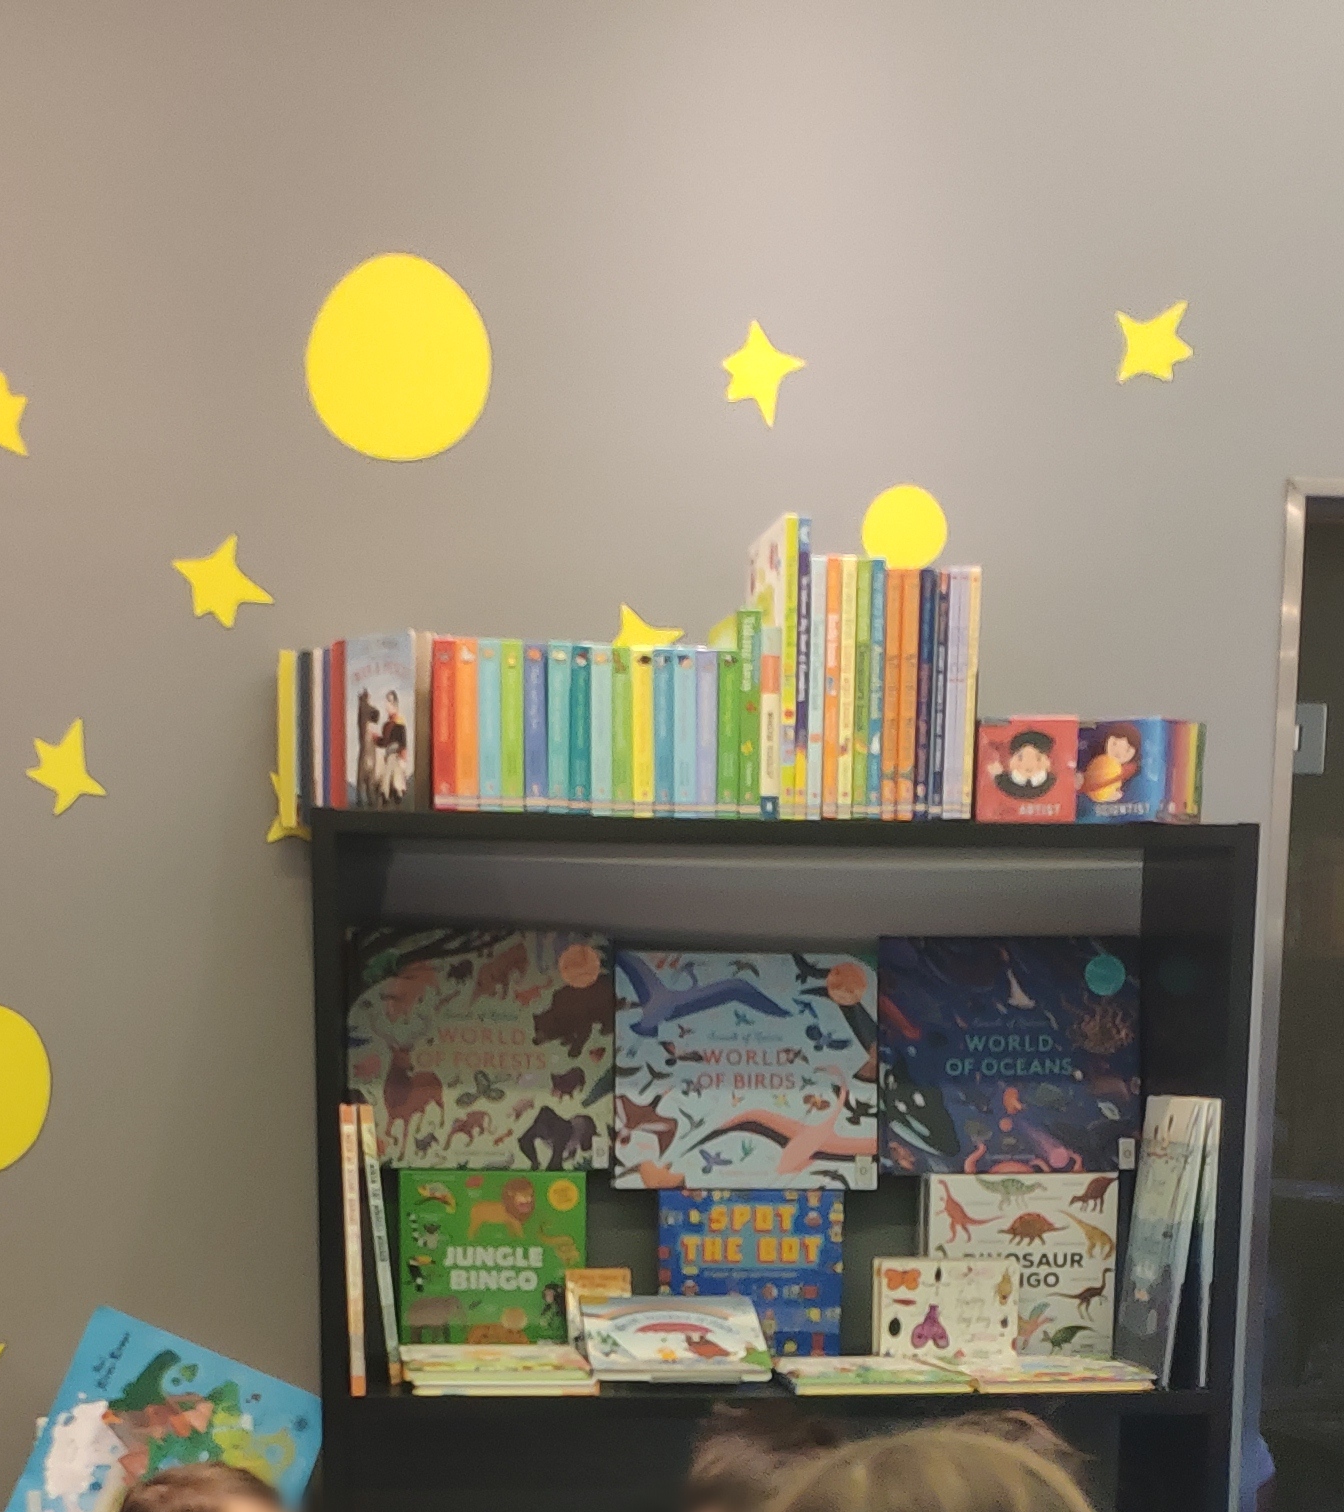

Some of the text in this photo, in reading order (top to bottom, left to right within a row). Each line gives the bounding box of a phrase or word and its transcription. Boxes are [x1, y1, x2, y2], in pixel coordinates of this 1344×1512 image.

[1018, 802, 1061, 816] ARTIST
[1094, 802, 1150, 817] SCIENTIST
[439, 1027, 526, 1046] WORLD
[965, 1034, 1054, 1053] WORLD
[415, 1051, 547, 1070] OF FORESTS
[703, 1048, 793, 1066] WORLD
[945, 1058, 1073, 1076] OF OCEANS
[697, 1072, 797, 1090] OF BIRDS
[708, 1204, 796, 1232] SPOT
[443, 1245, 544, 1267] JUNGLE
[680, 1236, 743, 1264] THE
[449, 1269, 538, 1291] BINGO
